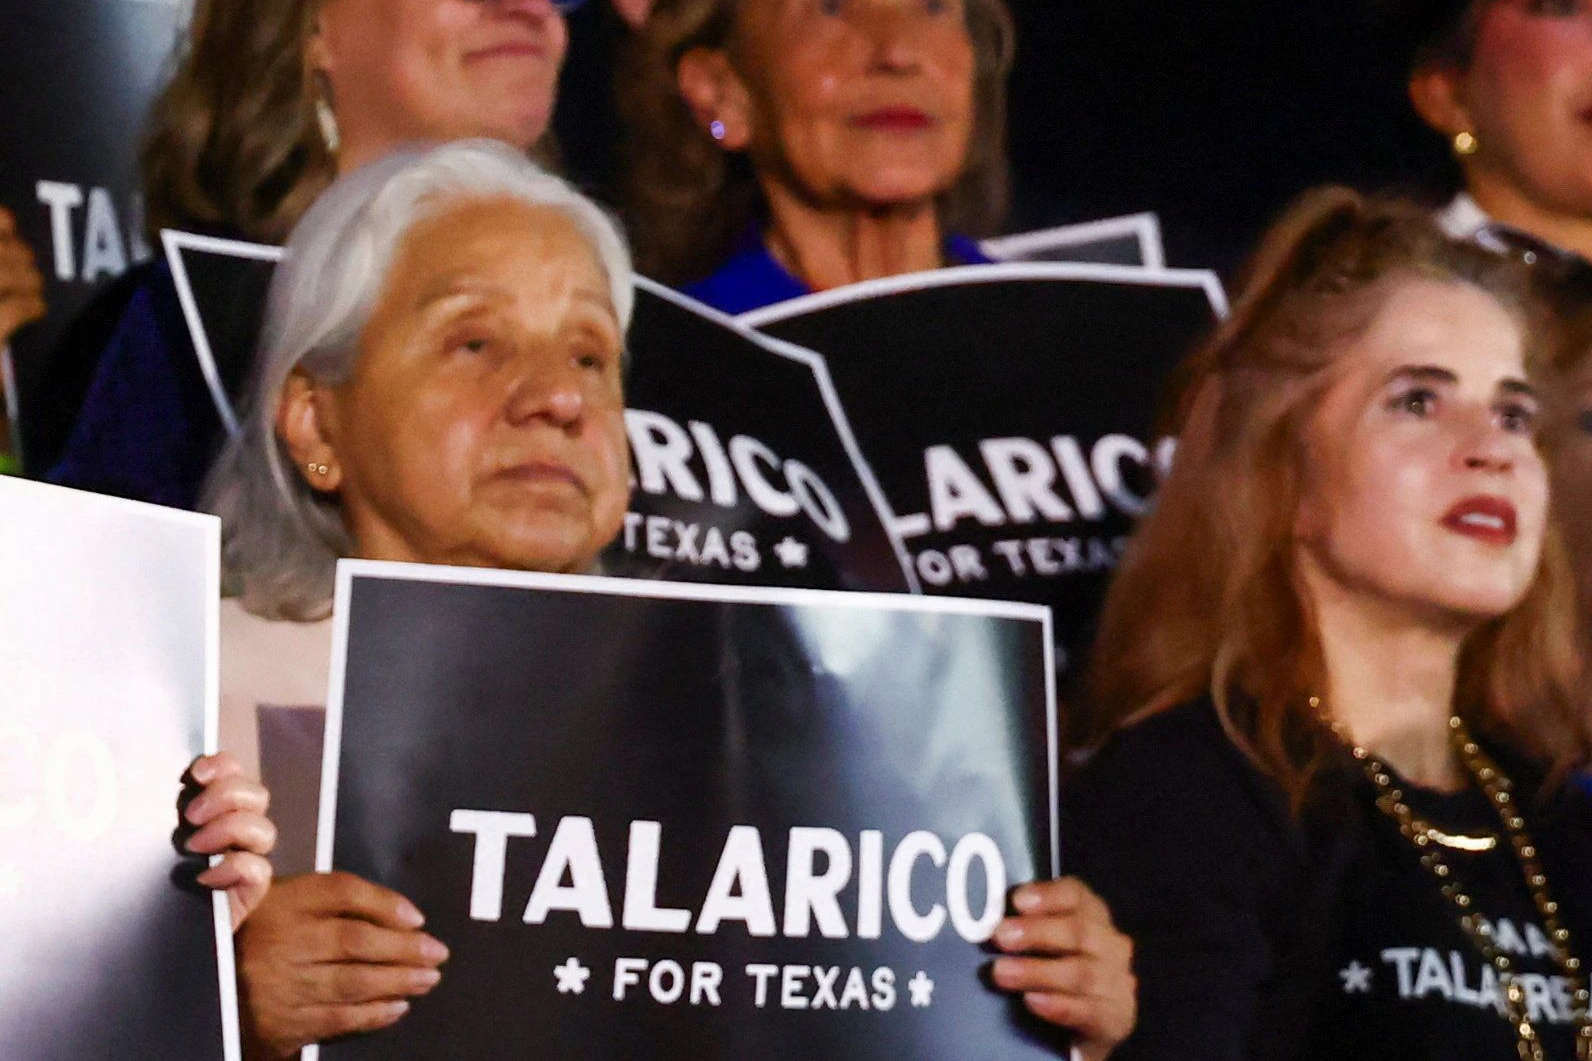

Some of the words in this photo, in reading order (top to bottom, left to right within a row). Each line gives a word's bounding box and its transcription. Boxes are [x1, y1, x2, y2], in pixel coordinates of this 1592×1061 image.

[624, 409, 850, 543] RICO
[910, 543, 988, 587] OR
[449, 808, 1005, 943] TALARICO
[613, 957, 723, 1006] FOR
[746, 963, 897, 1011] TEXAS
